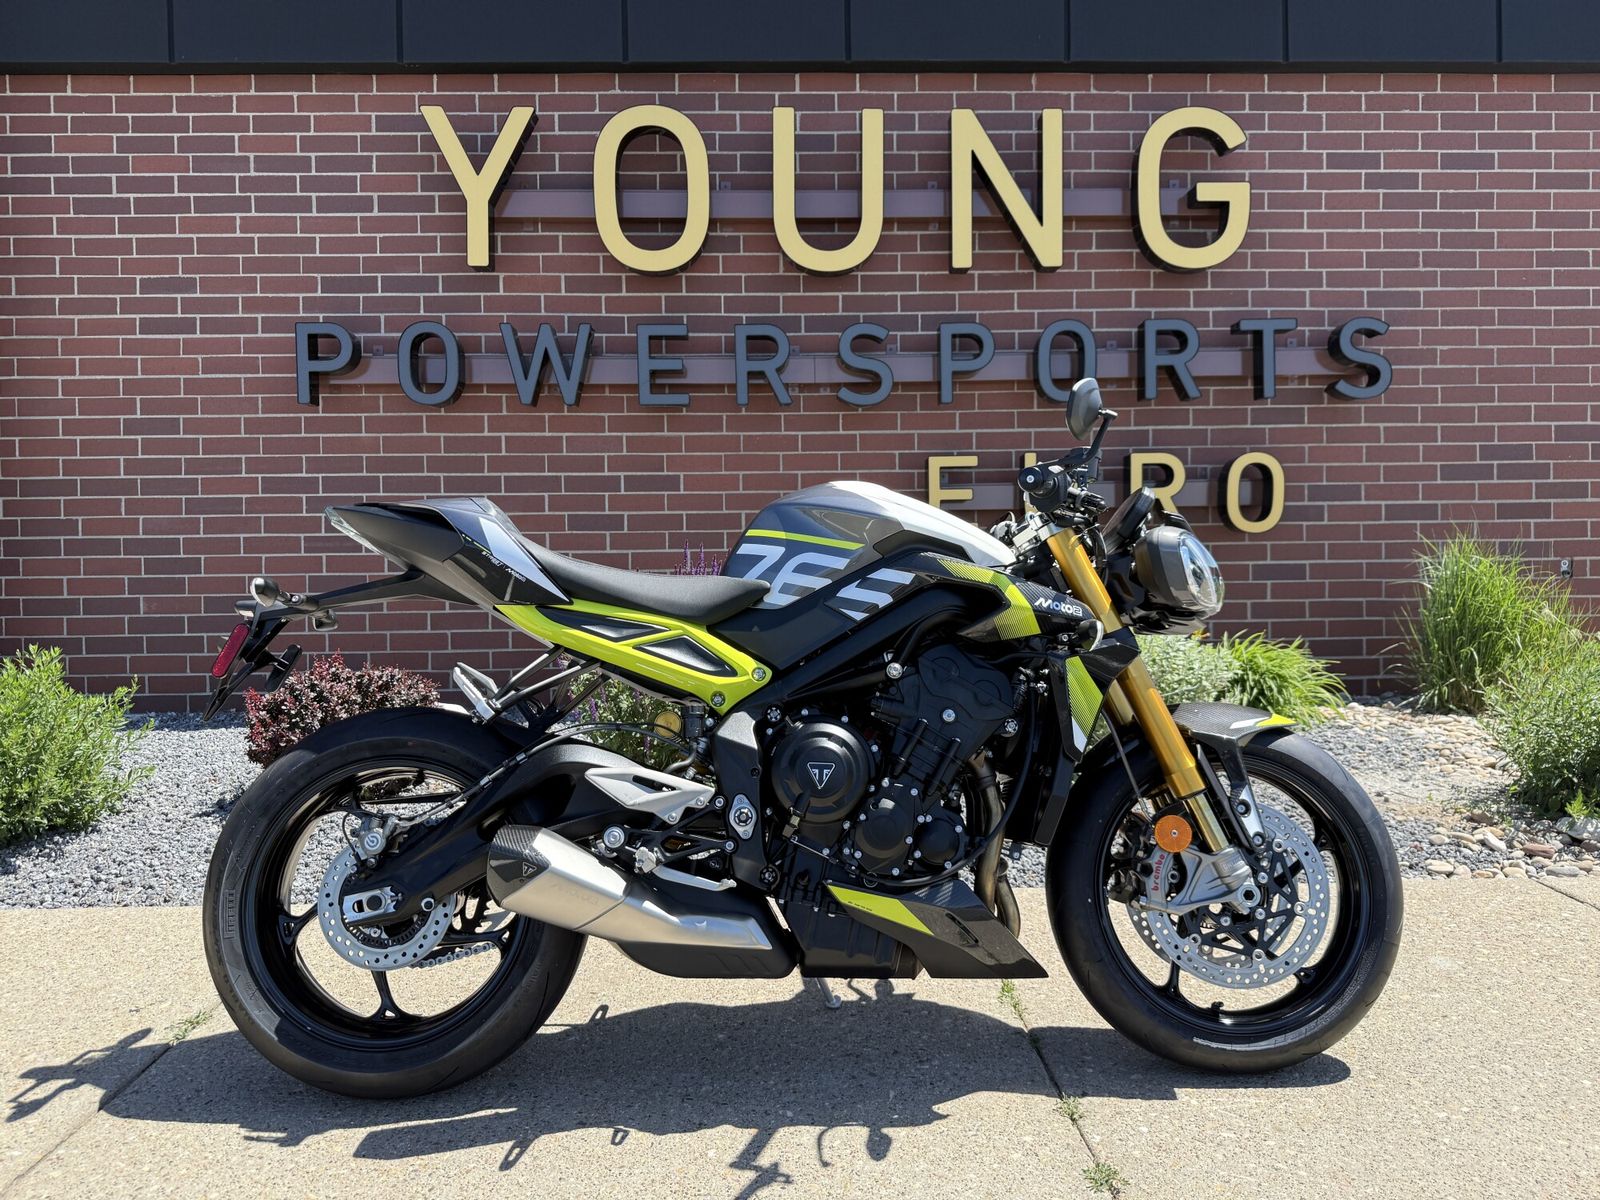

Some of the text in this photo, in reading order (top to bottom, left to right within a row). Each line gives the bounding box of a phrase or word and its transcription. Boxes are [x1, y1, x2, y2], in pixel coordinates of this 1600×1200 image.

[420, 104, 1252, 273] YOUNG
[294, 316, 1394, 407] POWERSPORTS
[927, 451, 1287, 534] ERO
[1034, 597, 1083, 617] Moto2
[1151, 853, 1166, 892] brembo
